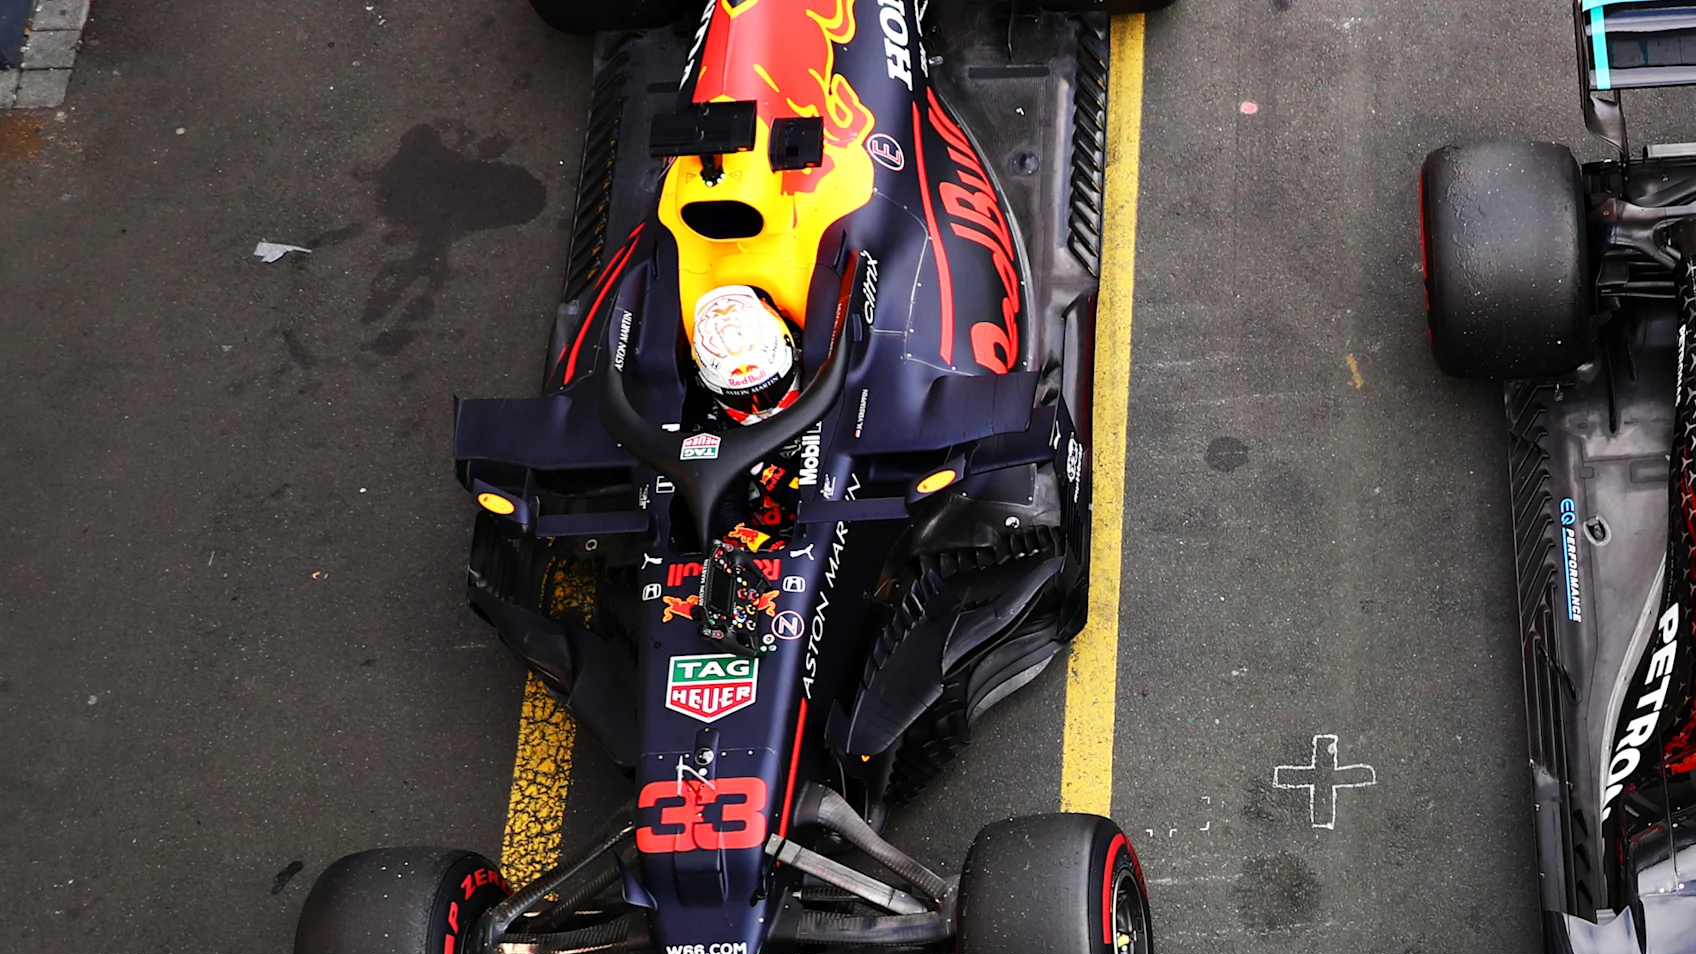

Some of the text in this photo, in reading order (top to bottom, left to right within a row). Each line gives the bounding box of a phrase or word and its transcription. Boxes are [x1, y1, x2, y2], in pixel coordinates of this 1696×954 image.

[860, 250, 878, 324] citrix
[728, 369, 767, 387] Red Bull
[751, 376, 779, 393] MARTIN
[799, 435, 821, 485] Mobil
[1566, 528, 1582, 623] PERFORMANCE
[676, 659, 750, 679] TAG
[803, 591, 829, 700] ASTON
[671, 685, 752, 714] HEUER
[1601, 602, 1680, 821] PETRO
[636, 777, 768, 854] 33
